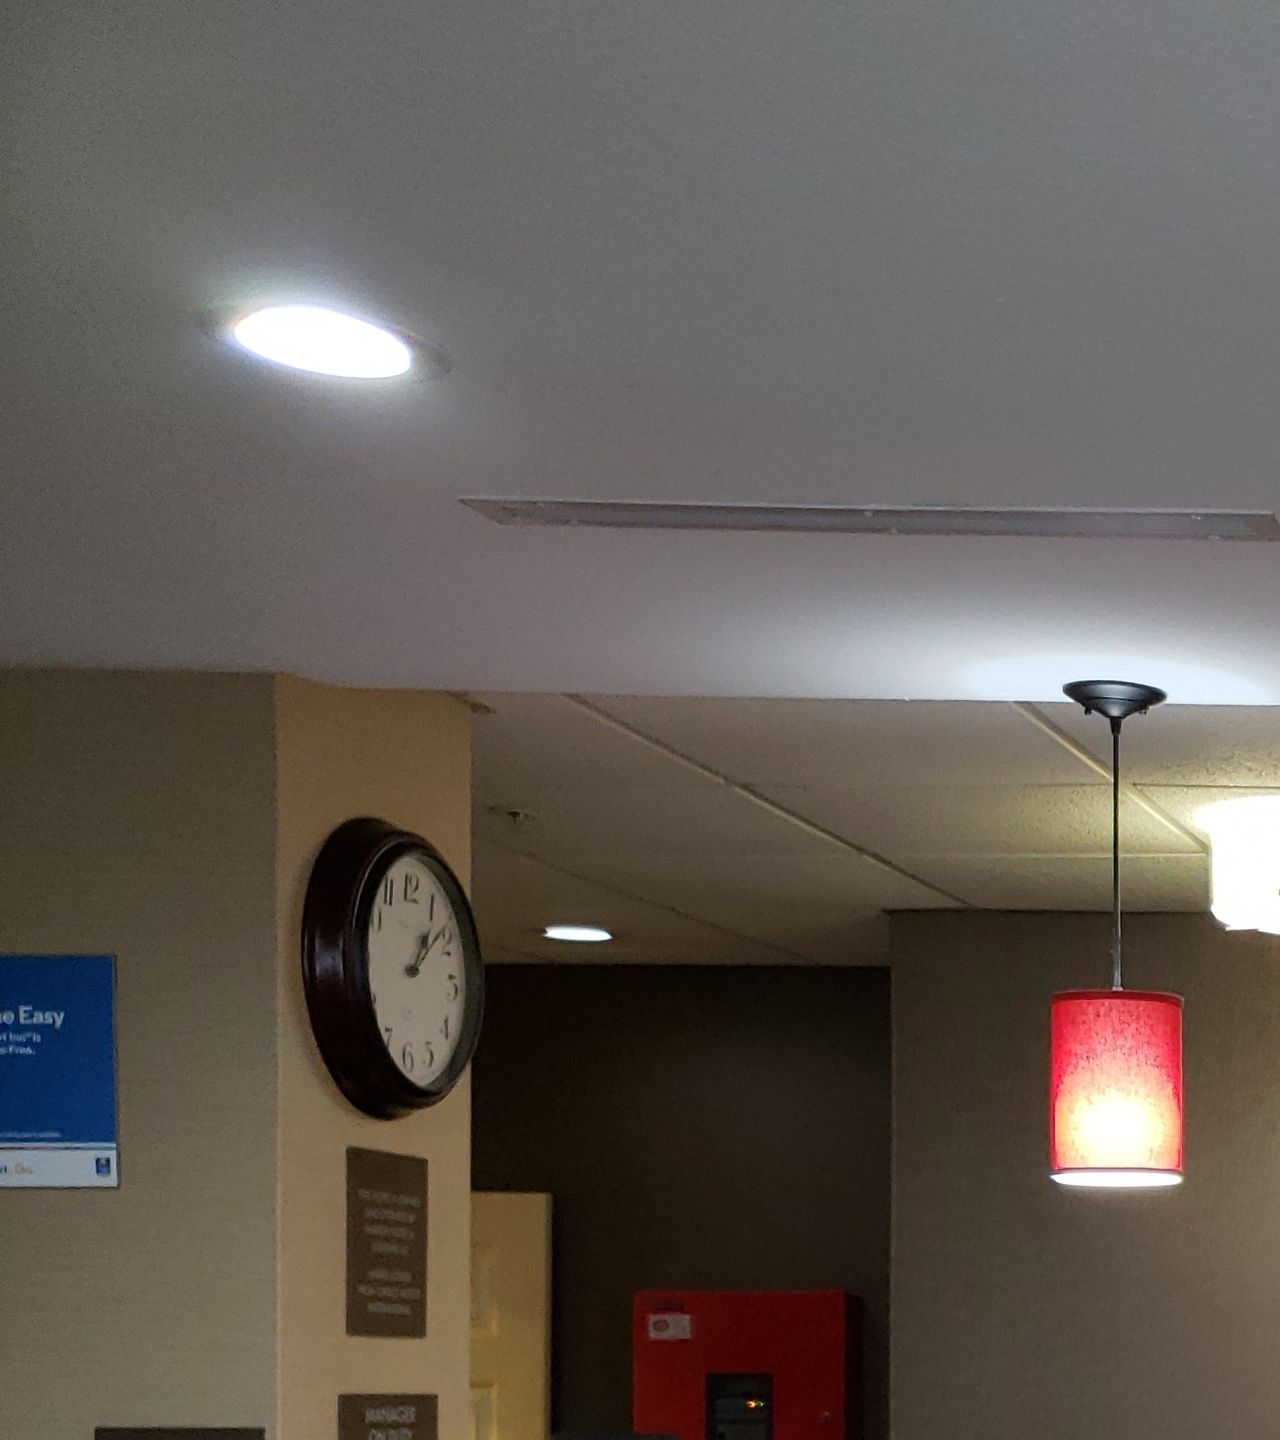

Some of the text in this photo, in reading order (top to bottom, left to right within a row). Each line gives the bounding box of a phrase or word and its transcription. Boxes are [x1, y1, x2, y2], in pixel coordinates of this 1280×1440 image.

[403, 873, 420, 905] 12
[429, 893, 435, 922] 1
[18, 1004, 66, 1030] Easy
[402, 1042, 415, 1074] 6
[422, 1040, 435, 1069] 5
